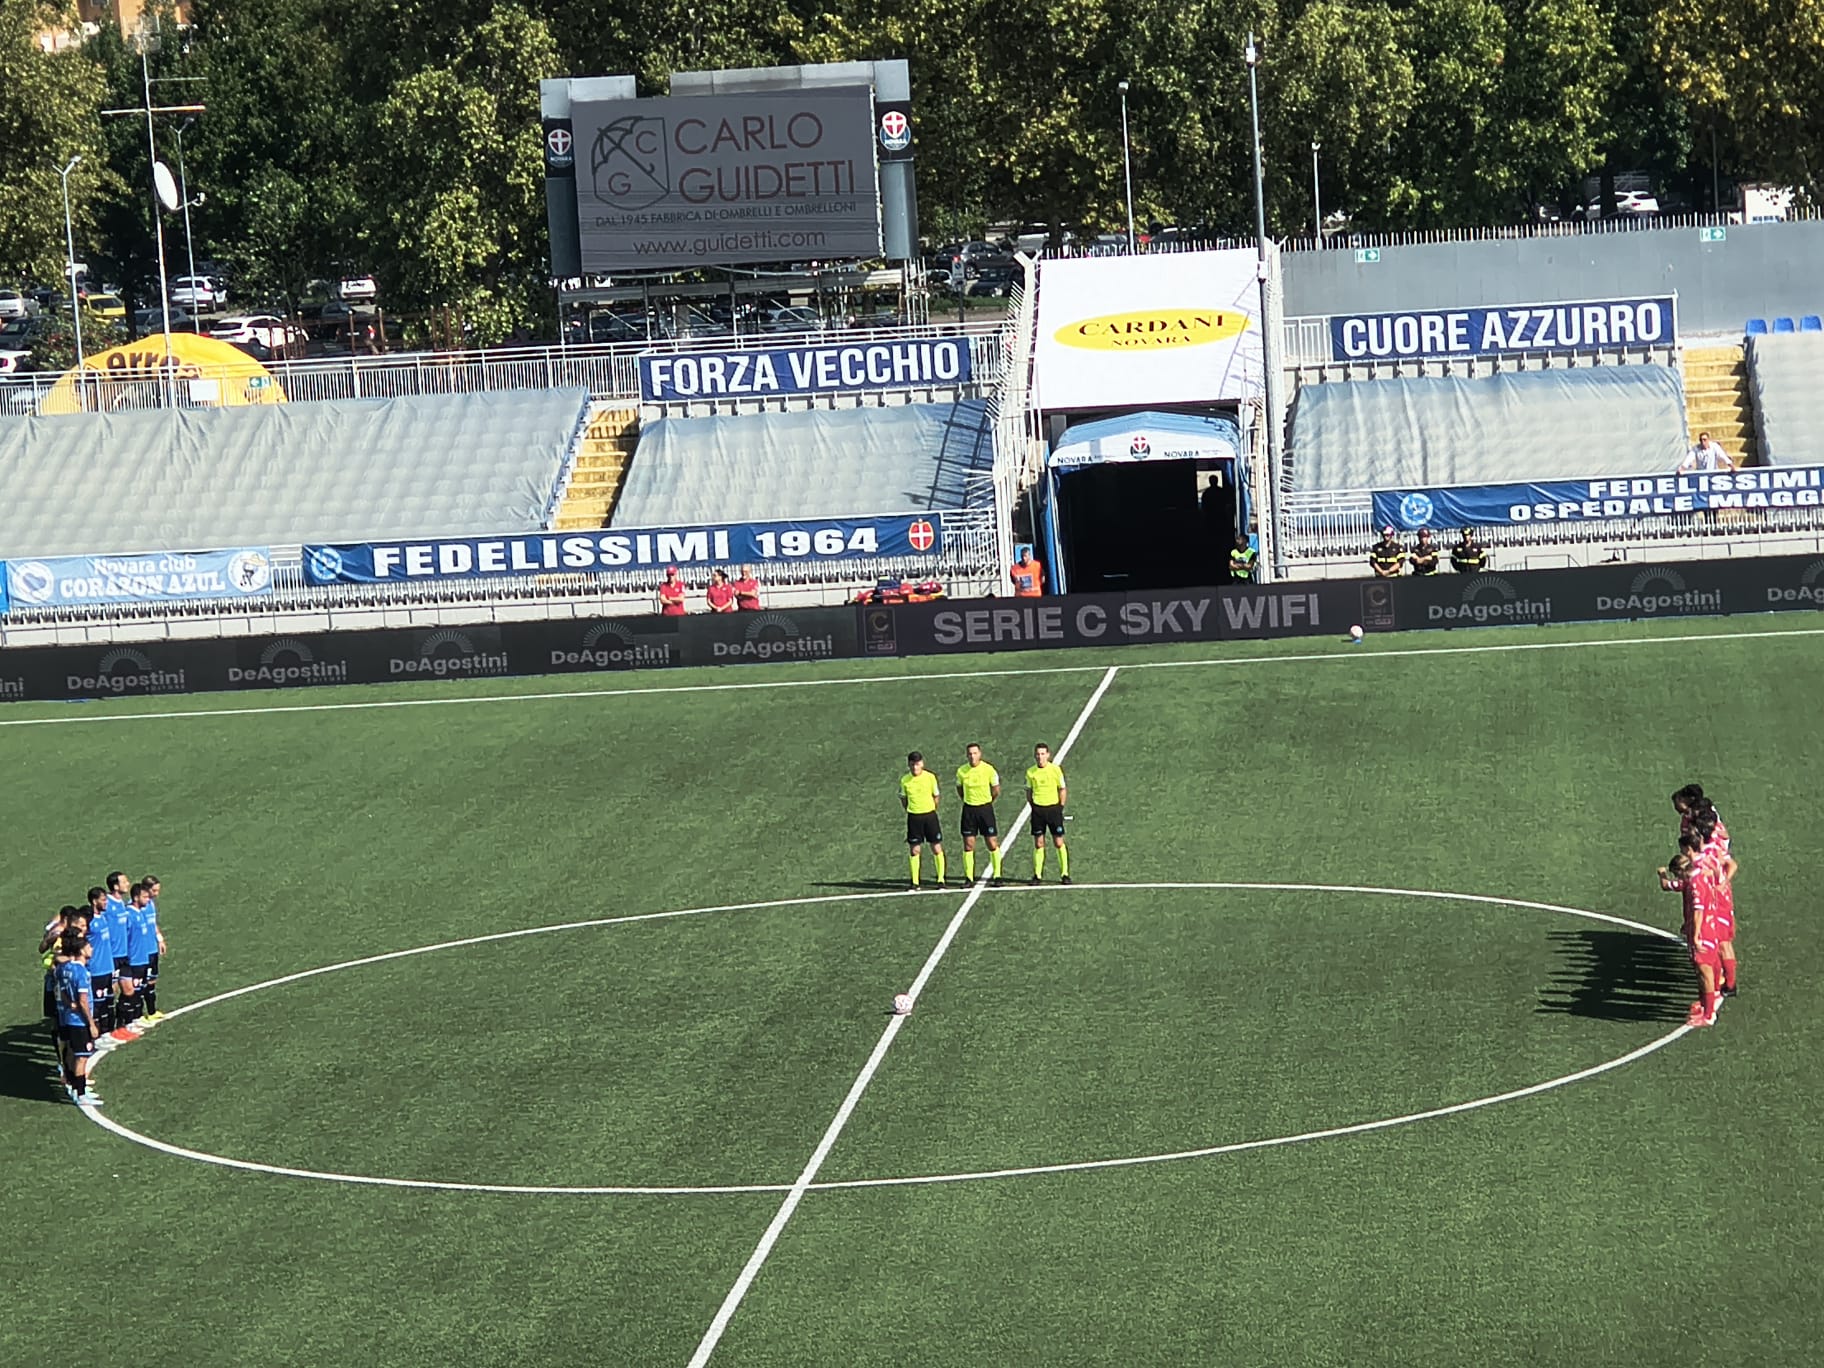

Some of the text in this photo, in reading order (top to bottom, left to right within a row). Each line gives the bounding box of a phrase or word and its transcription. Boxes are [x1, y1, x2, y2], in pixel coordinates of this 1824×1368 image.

[635, 130, 658, 154] C
[674, 112, 823, 155] CARLO
[607, 172, 631, 196] G
[678, 160, 855, 204] GUIDETTI
[651, 211, 700, 224] FABBRICA
[719, 206, 772, 219] OMBRELLI
[775, 206, 781, 216] E
[785, 202, 856, 215] OMBRELLONI
[633, 230, 825, 256] www.guidetti.com
[1079, 314, 1223, 336] CARDANI
[1342, 301, 1662, 357] CUORE AZZURRO
[1112, 335, 1191, 346] NOVARA
[650, 341, 960, 397] FORZA VECCHIO
[1057, 456, 1093, 464] NOVARA
[1164, 450, 1199, 458] NOVARA
[1589, 469, 1820, 499] FEDELISSIMI
[1509, 489, 1824, 522] OSPEDALE MAGG
[372, 527, 878, 578] FEDELISSIMI 1964
[94, 557, 196, 576] Novara club
[60, 572, 225, 598] CORAZON AZUL
[1428, 598, 1551, 621] DeAgostini
[1597, 589, 1721, 612] DeAgostini
[933, 594, 1320, 645] SERIE C SKY WIFI
[551, 644, 670, 666] DeAgostini
[713, 634, 833, 658] DeAgostini
[228, 661, 347, 683] DeAgostini
[389, 652, 507, 675] DeAgostini
[67, 669, 185, 692] DeAgostini
